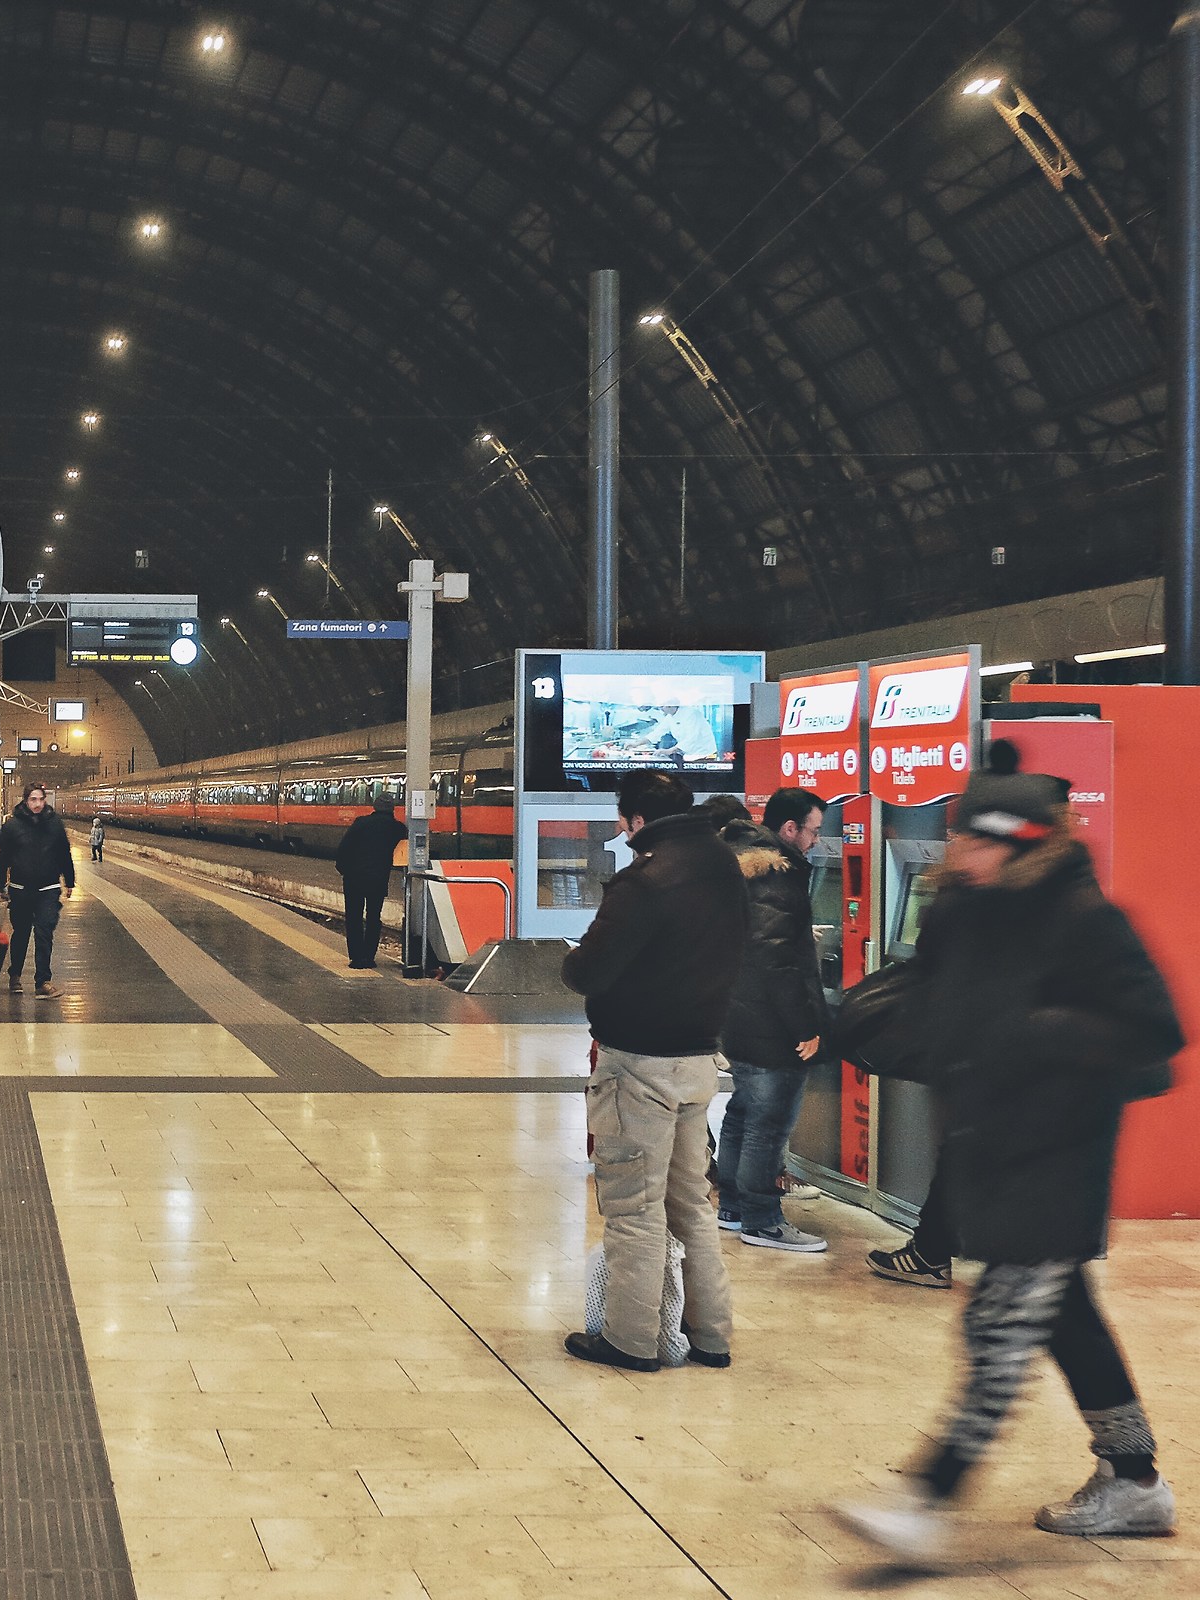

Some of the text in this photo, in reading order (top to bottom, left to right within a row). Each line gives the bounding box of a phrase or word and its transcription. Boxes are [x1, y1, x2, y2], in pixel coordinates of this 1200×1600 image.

[292, 622, 362, 632] Zona fumatori
[532, 677, 555, 699] 13
[900, 704, 951, 718] TRENITALIA
[804, 715, 845, 728] TRENITALIA
[798, 751, 839, 776] Biglietti
[892, 744, 944, 772] Biglietti
[798, 774, 817, 787] Tickets
[892, 771, 916, 785] Tickets
[413, 797, 424, 807] 13
